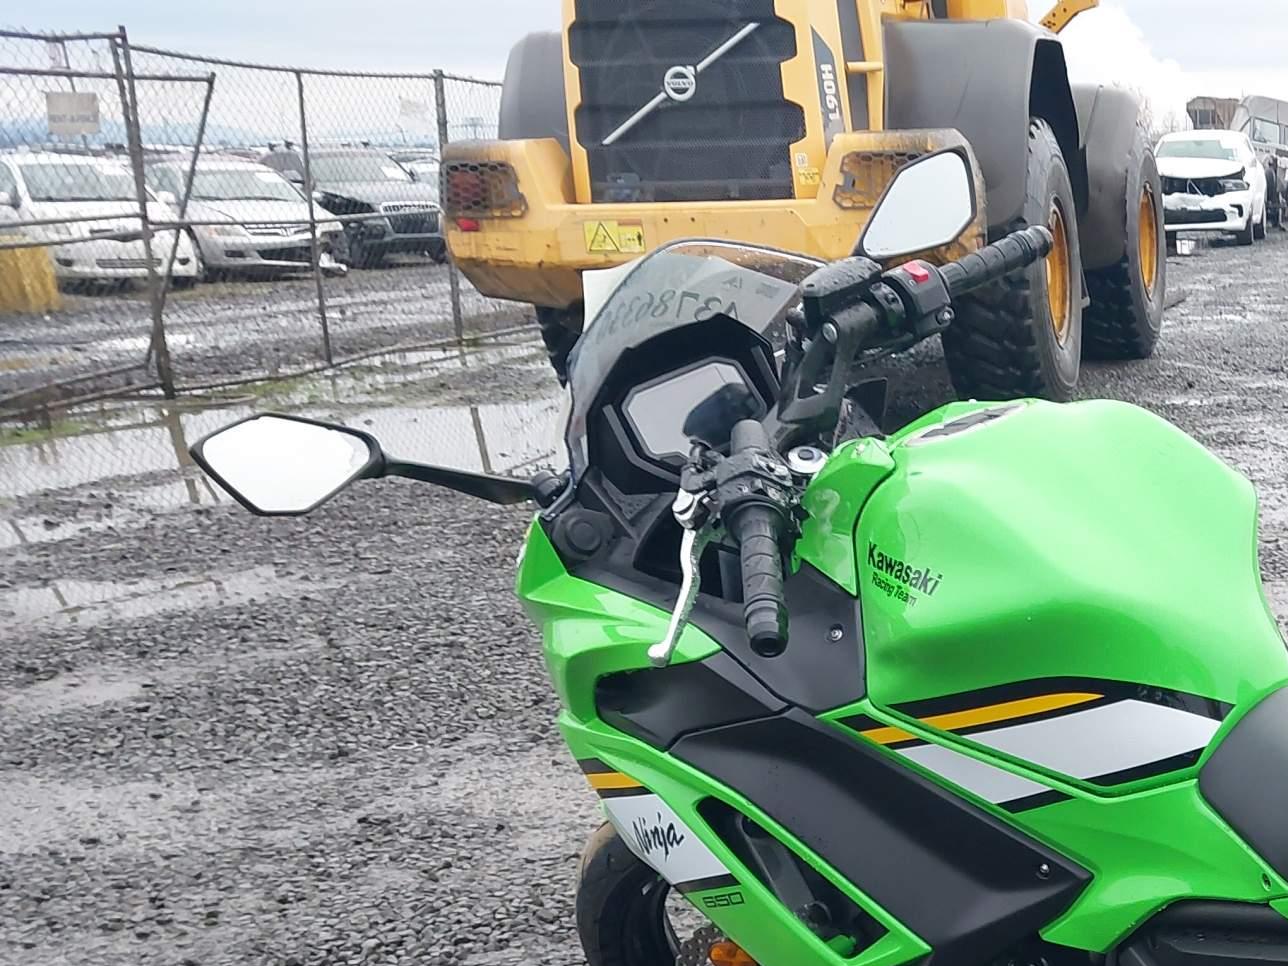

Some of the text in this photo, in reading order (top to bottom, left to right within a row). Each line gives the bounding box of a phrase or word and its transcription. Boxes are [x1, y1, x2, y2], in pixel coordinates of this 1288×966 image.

[666, 79, 694, 87] VOLVO
[820, 63, 841, 120] L90H
[867, 540, 943, 596] Kawasaki
[871, 571, 918, 607] Racing Team
[632, 811, 685, 862] Ninja
[702, 891, 745, 908] 650
